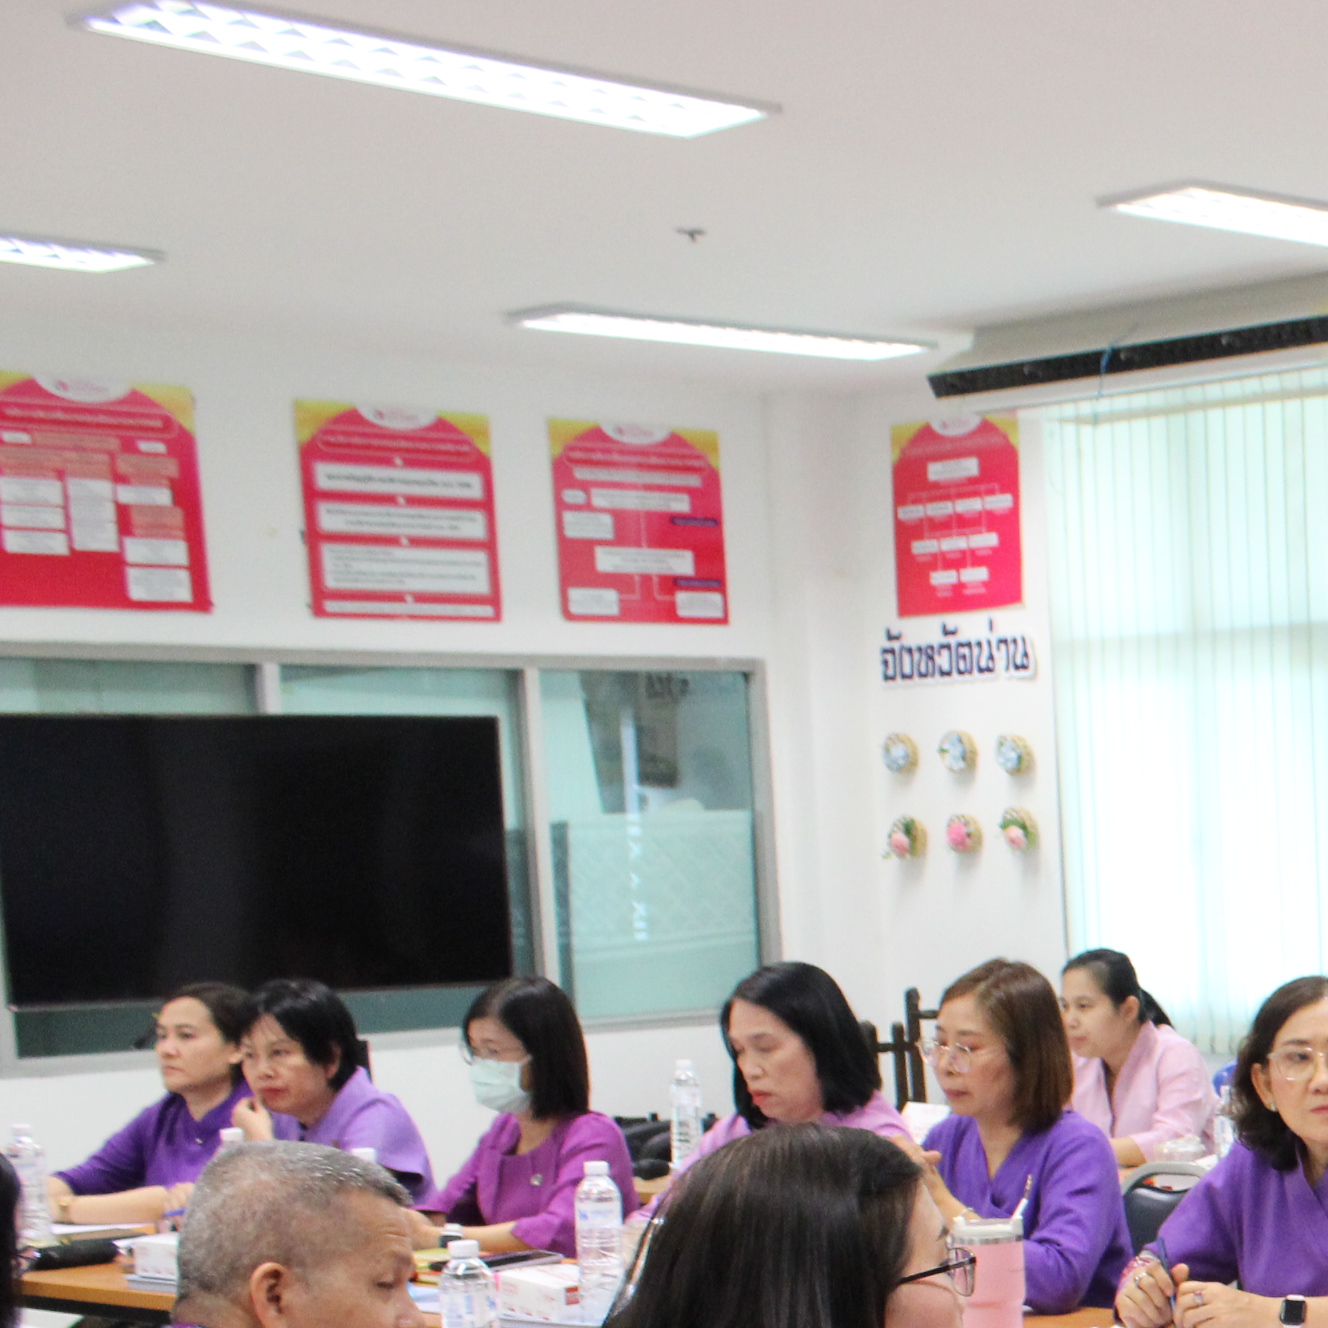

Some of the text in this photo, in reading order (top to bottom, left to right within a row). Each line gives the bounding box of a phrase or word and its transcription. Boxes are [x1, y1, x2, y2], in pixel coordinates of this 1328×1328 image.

[881, 617, 1030, 682] จังหวัดน่าน
